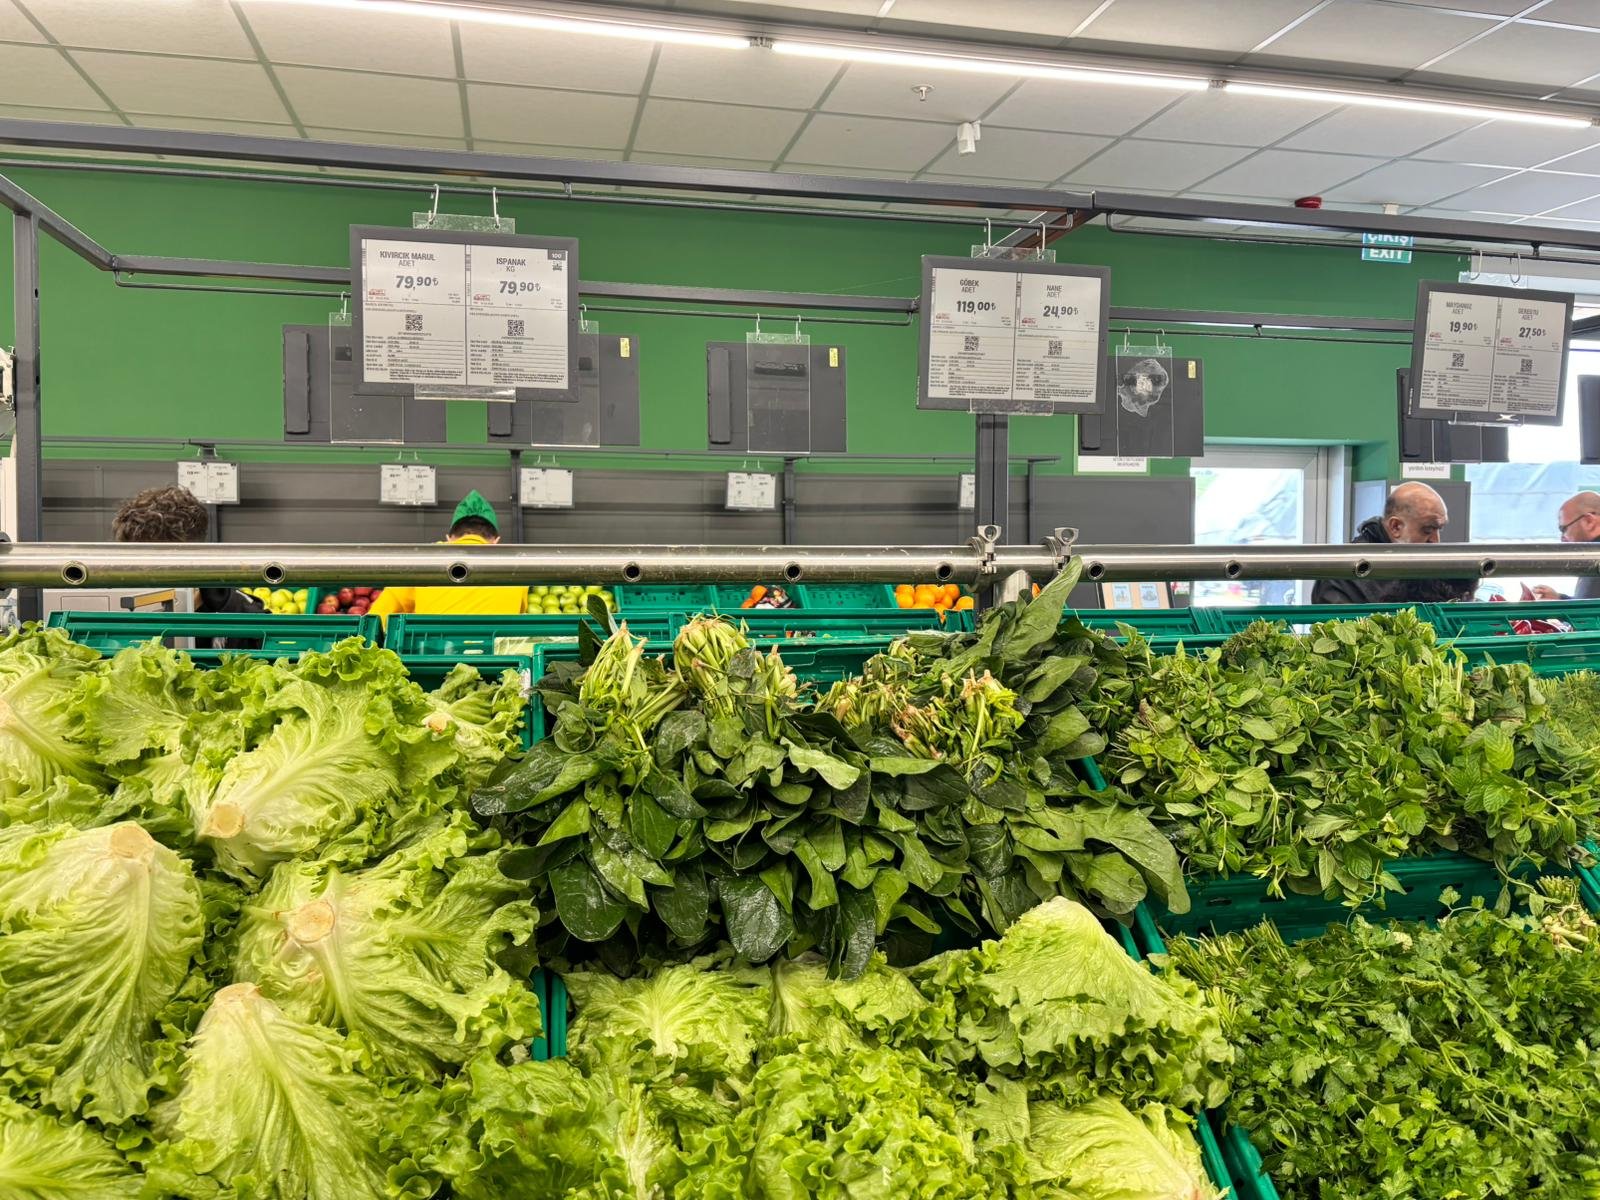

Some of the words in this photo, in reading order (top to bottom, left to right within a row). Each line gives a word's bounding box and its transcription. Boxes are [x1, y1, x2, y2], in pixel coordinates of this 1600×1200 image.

[379, 250, 410, 260] KIVIRCIK
[411, 251, 436, 261] MARUL
[1370, 248, 1402, 259] EXIT
[398, 259, 415, 267] ADET
[496, 257, 526, 267] ISPANAK
[959, 278, 979, 287] GÖBEK
[961, 286, 975, 294] ADET
[1046, 284, 1062, 292] NANE
